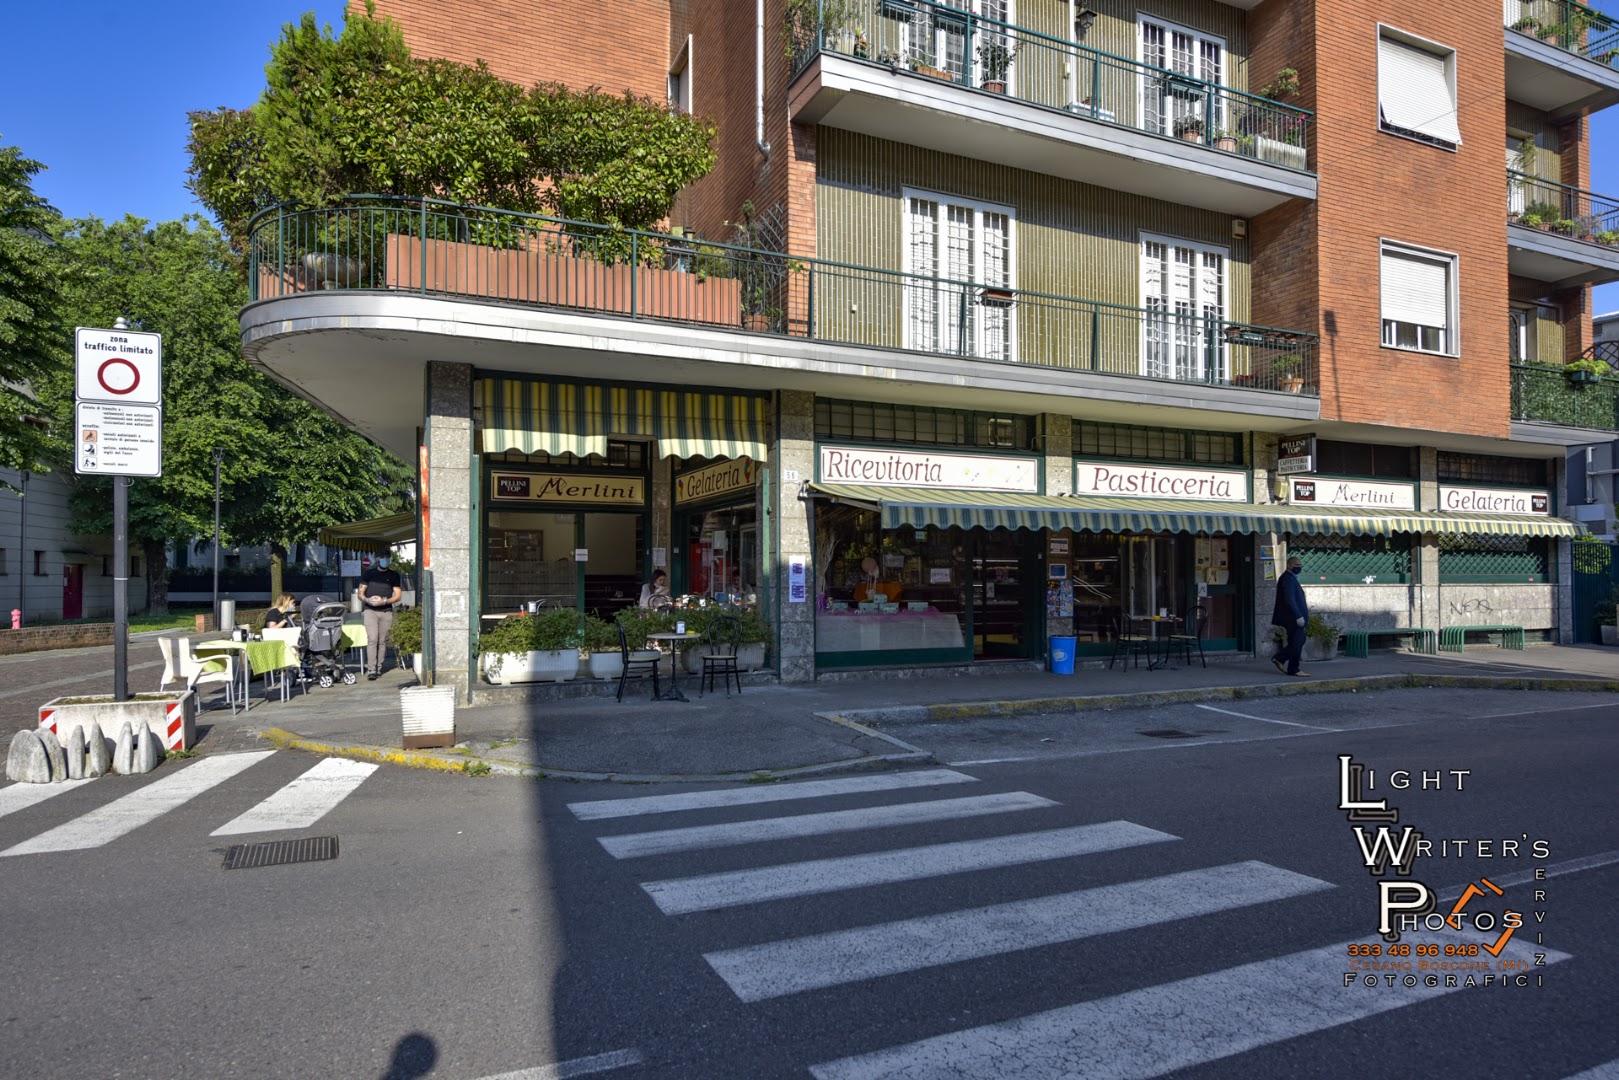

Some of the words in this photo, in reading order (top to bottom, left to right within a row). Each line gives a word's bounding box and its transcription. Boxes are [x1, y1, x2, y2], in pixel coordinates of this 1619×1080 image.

[84, 342, 117, 351] traffico
[120, 345, 153, 354] limitato
[1281, 440, 1306, 449] PELLINI
[827, 451, 943, 482] Ricevitoria
[500, 479, 527, 487] PELLINI
[507, 485, 521, 493] TOP
[537, 477, 635, 498] Merlini
[687, 465, 740, 497] Gelateria
[1091, 467, 1232, 497] Pasticceria
[1331, 483, 1395, 503] Merlini
[1447, 490, 1526, 512] Gelateria
